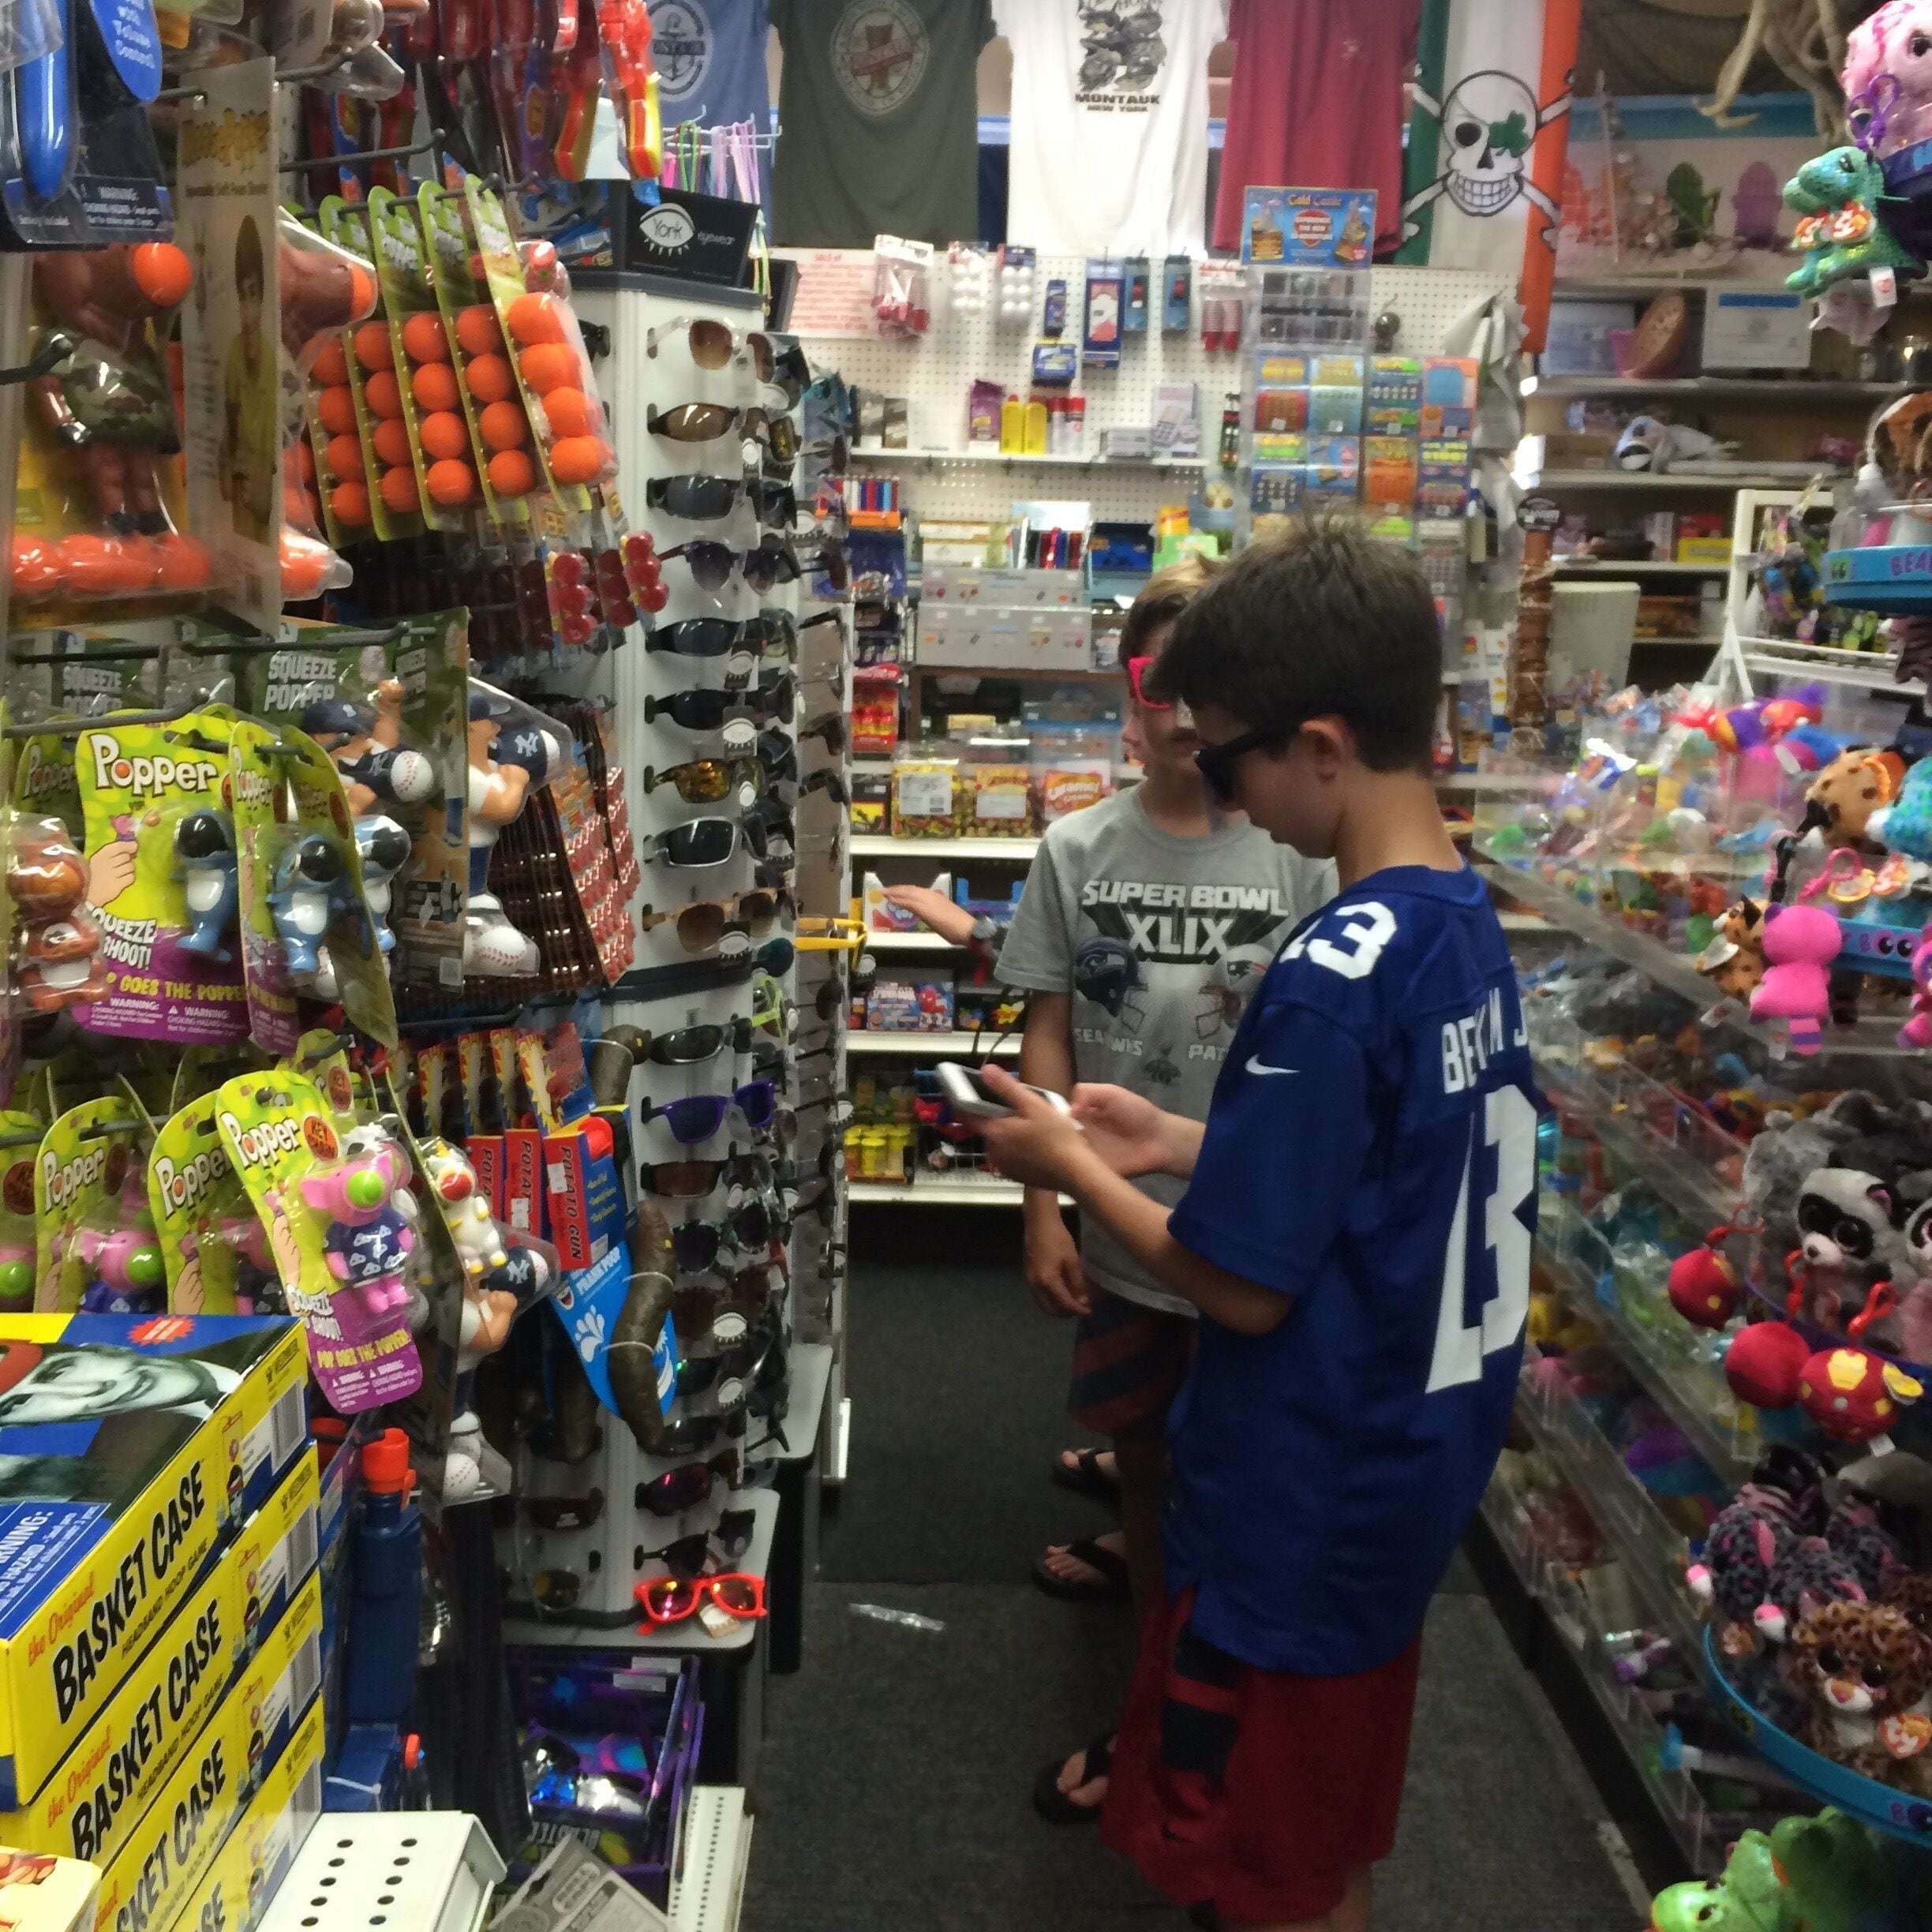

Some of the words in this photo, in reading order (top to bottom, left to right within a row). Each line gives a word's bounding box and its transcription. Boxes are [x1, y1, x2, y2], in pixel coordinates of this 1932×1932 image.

[1074, 93, 1160, 104] MONTAUK
[652, 218, 683, 241] York
[268, 651, 338, 683] SQUEEZE
[88, 733, 219, 798] Popper
[1081, 880, 1186, 908] SUPER
[1190, 885, 1290, 916] BOWL
[1125, 913, 1234, 955] XLIX
[110, 997, 160, 1011] WARNING:
[120, 975, 159, 997] GOES
[164, 980, 192, 1000] THE
[197, 984, 248, 1002] POPPE
[184, 1006, 230, 1019] WARNING:
[220, 1111, 301, 1170] Popper
[43, 1147, 104, 1216] Popper
[482, 1148, 494, 1197] POTA
[520, 1139, 533, 1200] POTAT
[560, 1146, 578, 1218] POTATO
[568, 1224, 582, 1260] GUN
[1425, 1083, 1538, 1395] 13
[576, 1260, 605, 1295] PRANK
[28, 1629, 46, 1667] the
[48, 1570, 95, 1646] Original
[52, 1538, 148, 1724] BASKET
[151, 1460, 206, 1580] CASE
[121, 1596, 163, 1659] HEADBAND
[164, 1564, 185, 1601] HOOP
[187, 1538, 208, 1571] GAME
[71, 1683, 163, 1862] BASKET
[167, 1597, 223, 1723] CASE
[47, 1795, 65, 1828] the
[67, 1724, 111, 1803] Original
[117, 1831, 169, 1932] SKET
[174, 1738, 227, 1867] CASE
[200, 1881, 227, 1932] SE
